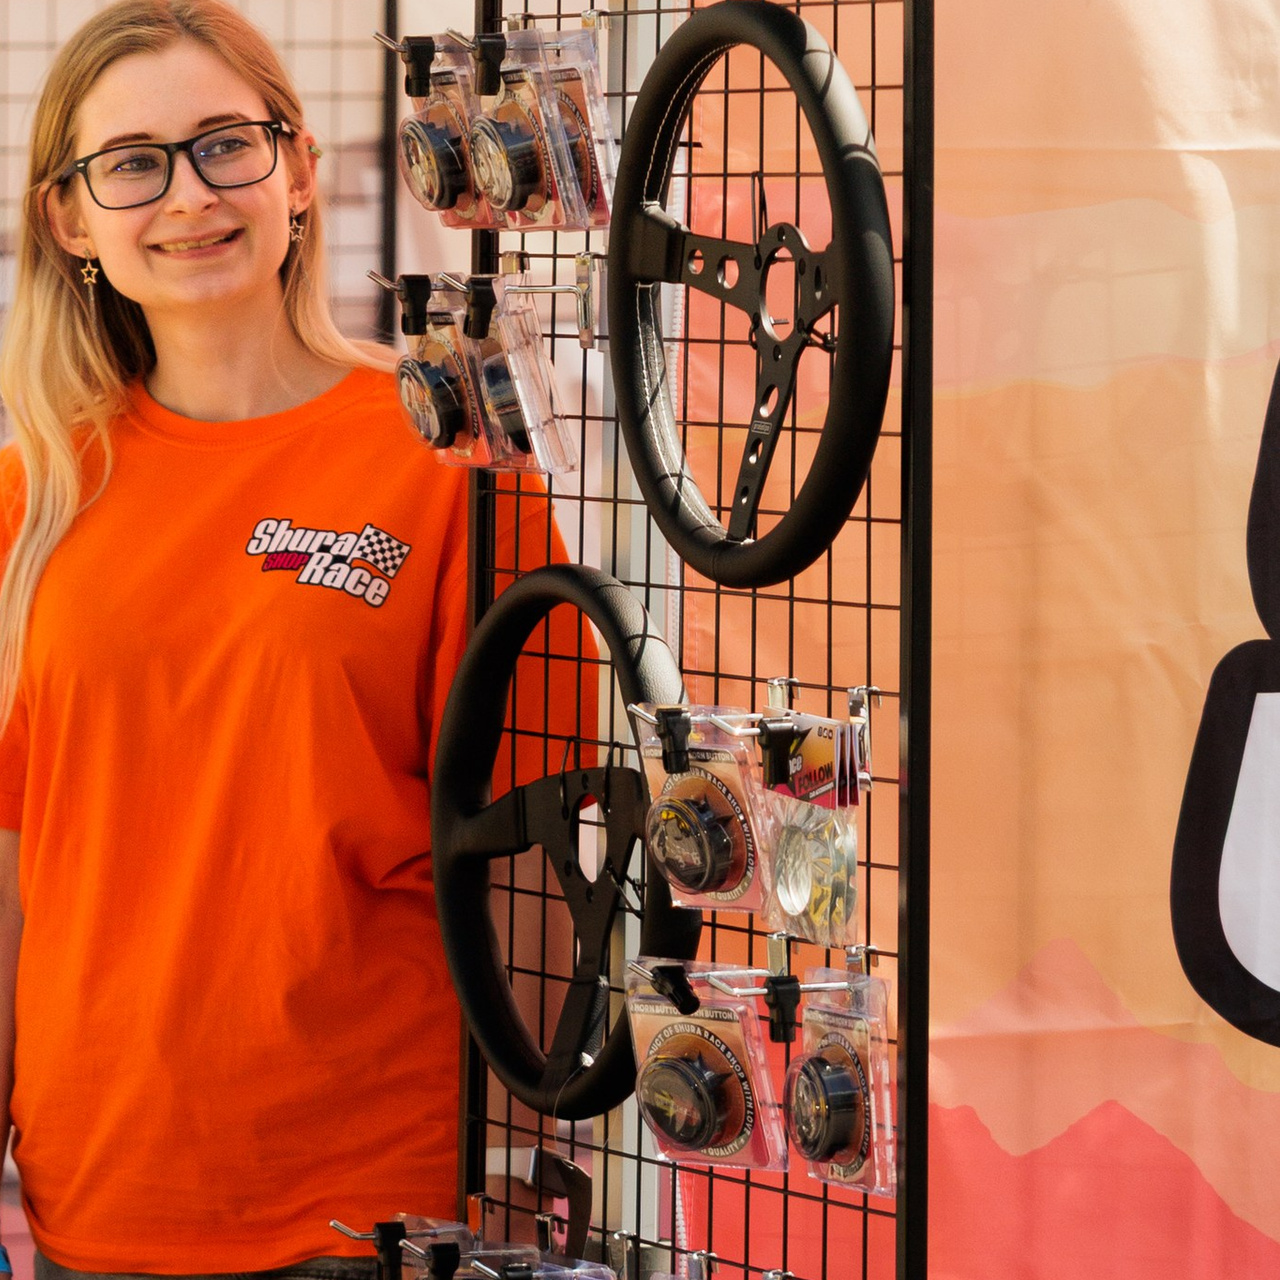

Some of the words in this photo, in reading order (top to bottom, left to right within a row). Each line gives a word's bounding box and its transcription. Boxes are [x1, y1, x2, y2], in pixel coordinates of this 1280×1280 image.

[246, 518, 360, 556] Shura
[262, 552, 310, 572] SHOP
[296, 551, 391, 608] Race
[706, 774, 728, 795] RACE
[798, 761, 833, 793] FOLLOW
[741, 823, 755, 852] WITH
[746, 853, 756, 879] LOVE
[655, 1005, 681, 1015] BUTTO
[704, 1009, 734, 1020] BUTTON
[663, 1025, 675, 1038] OF
[674, 1023, 702, 1036] SHURA
[703, 1031, 726, 1053] RACE
[725, 1051, 745, 1079] SHOP
[741, 1080, 754, 1109] WITH
[744, 1109, 754, 1135] LOVE
[708, 1141, 740, 1157] QUALITY
